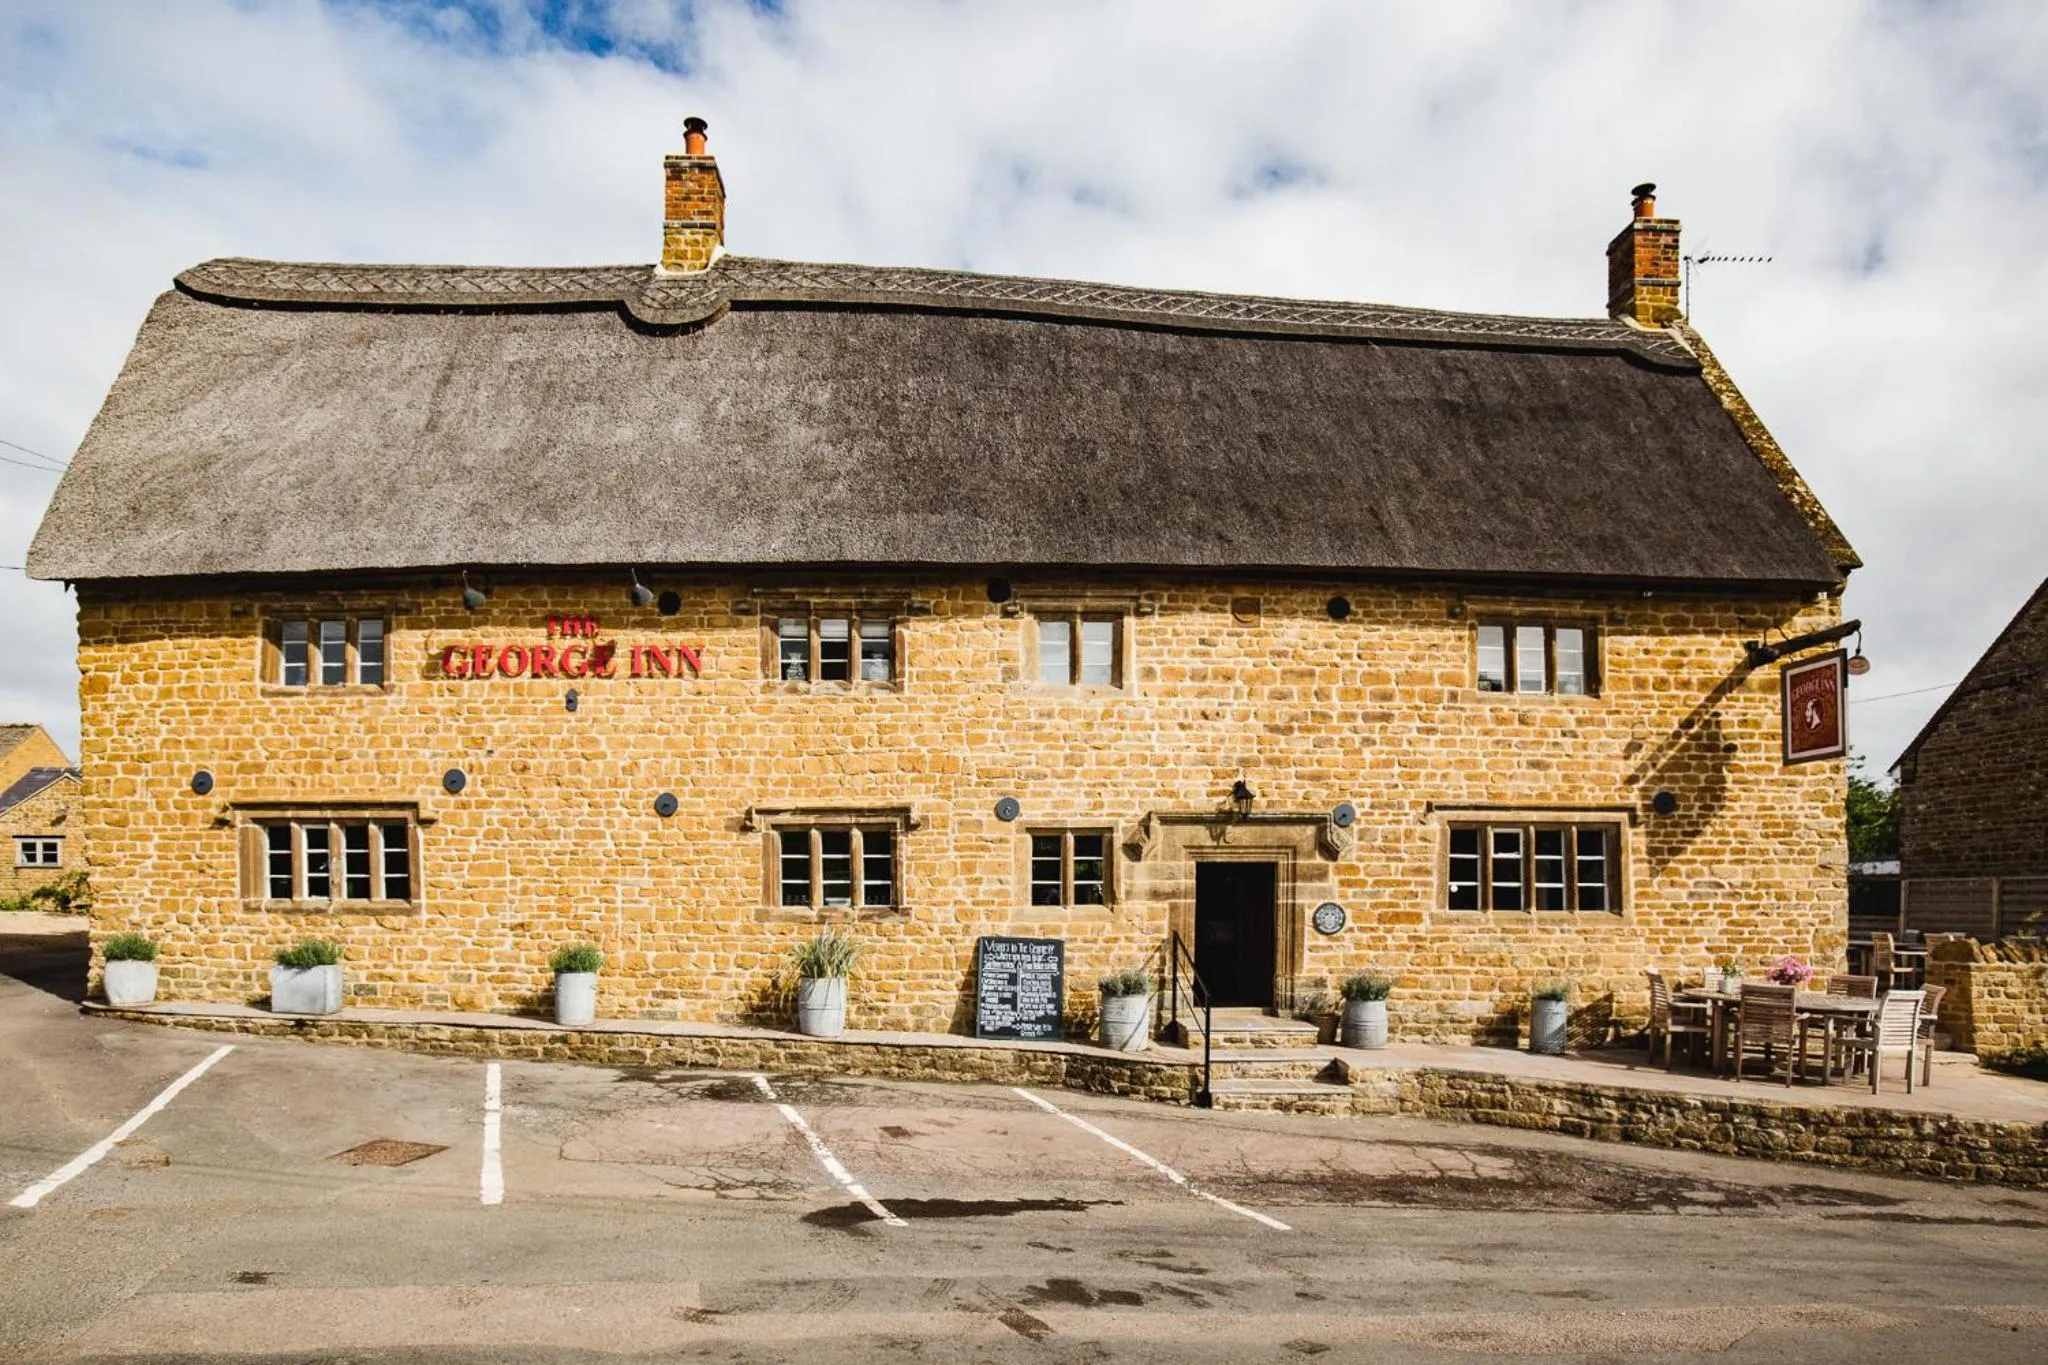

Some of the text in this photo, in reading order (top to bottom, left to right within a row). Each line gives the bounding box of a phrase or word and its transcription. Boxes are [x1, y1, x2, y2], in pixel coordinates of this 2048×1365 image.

[549, 614, 599, 637] THE
[442, 642, 704, 678] GEORGE INN
